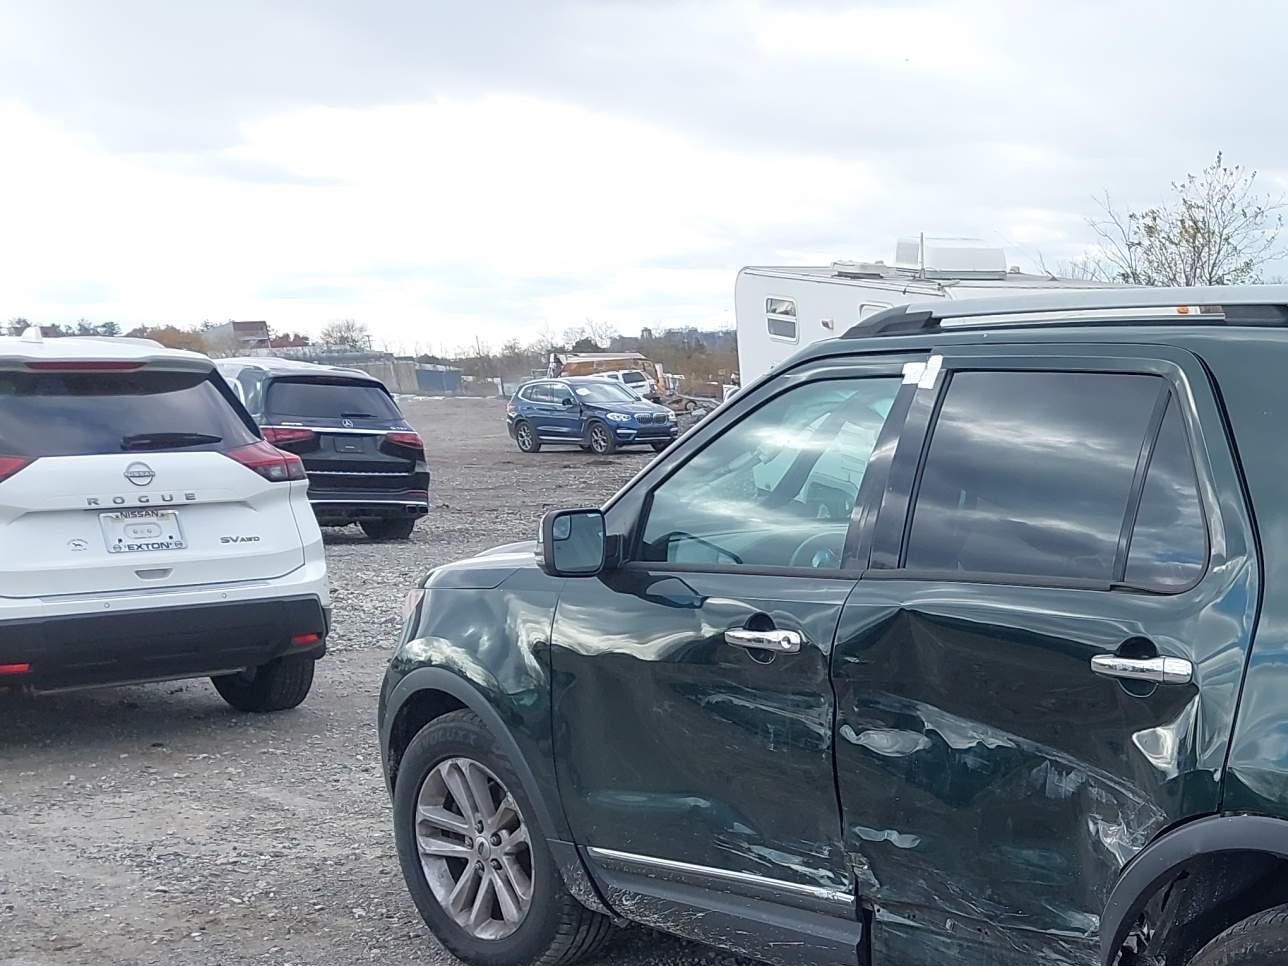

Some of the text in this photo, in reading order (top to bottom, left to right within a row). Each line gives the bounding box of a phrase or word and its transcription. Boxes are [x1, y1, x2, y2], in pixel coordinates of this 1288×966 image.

[87, 492, 197, 506] ROGUE
[120, 510, 159, 519] NISSAN
[127, 541, 170, 551] EXTON
